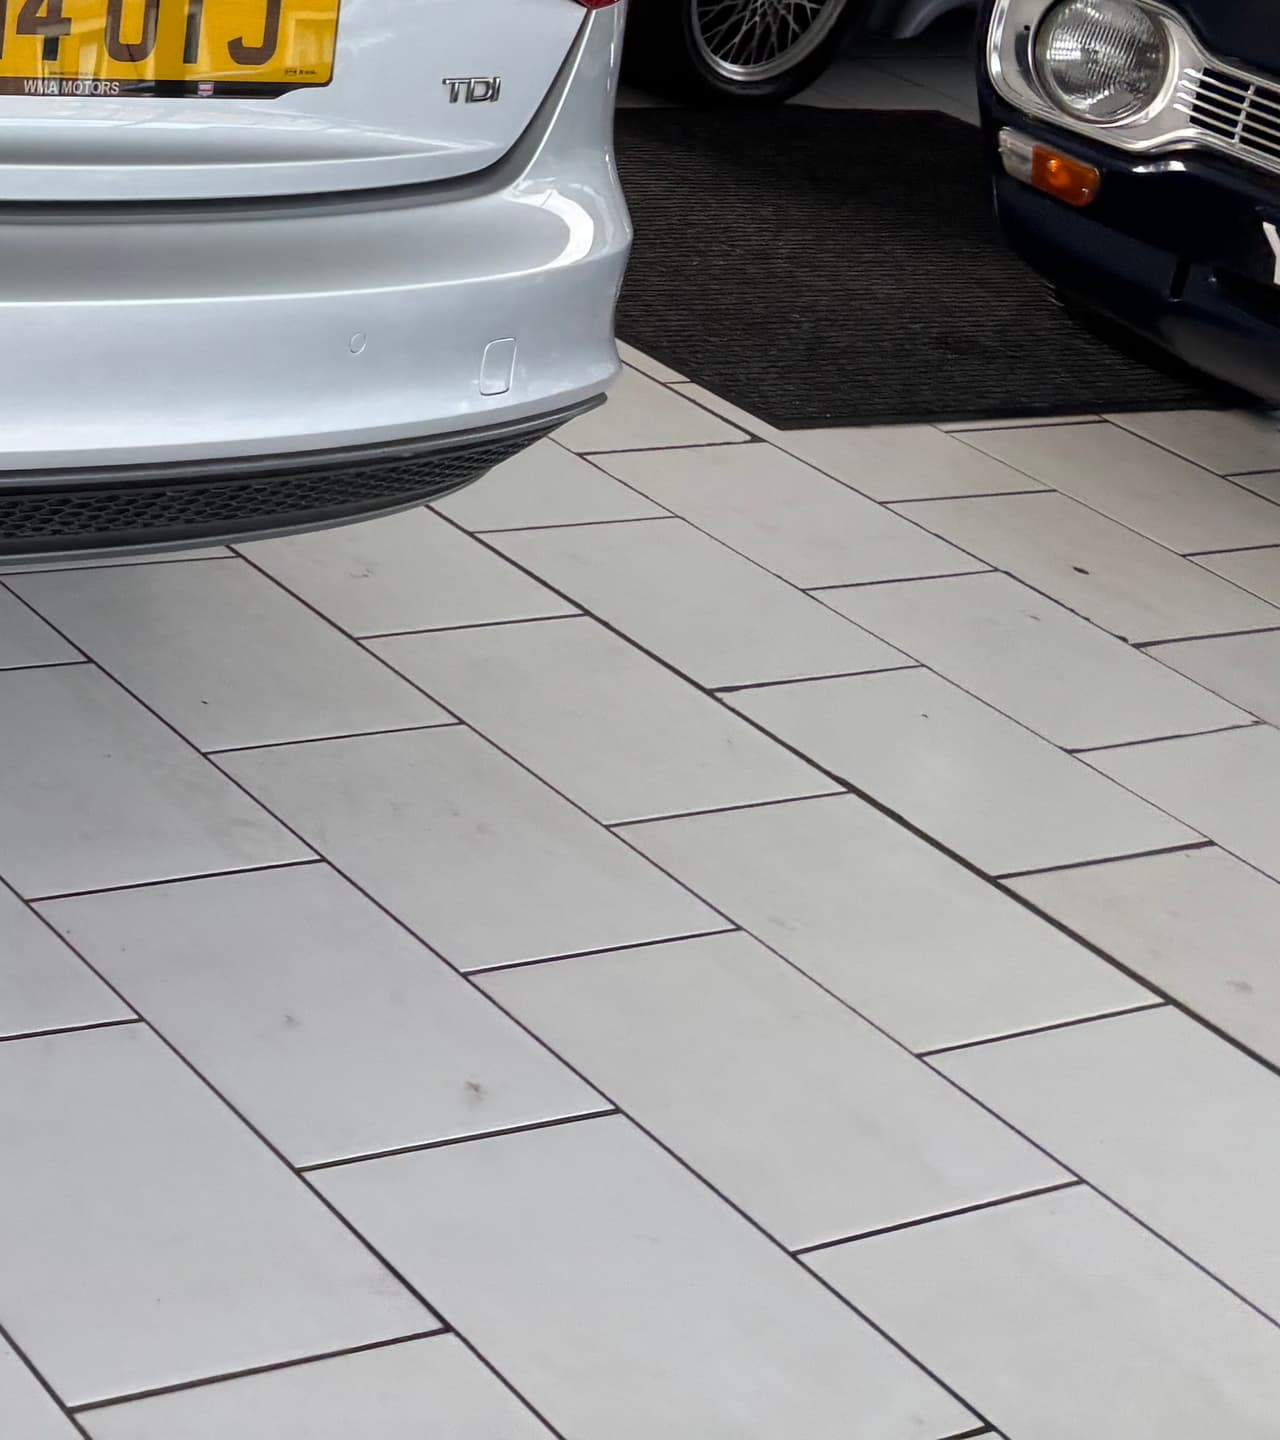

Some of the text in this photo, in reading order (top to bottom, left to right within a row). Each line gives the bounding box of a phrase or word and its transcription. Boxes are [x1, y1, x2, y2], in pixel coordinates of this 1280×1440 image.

[24, 79, 120, 95] WMA MOTORS
[442, 76, 501, 104] TDI
